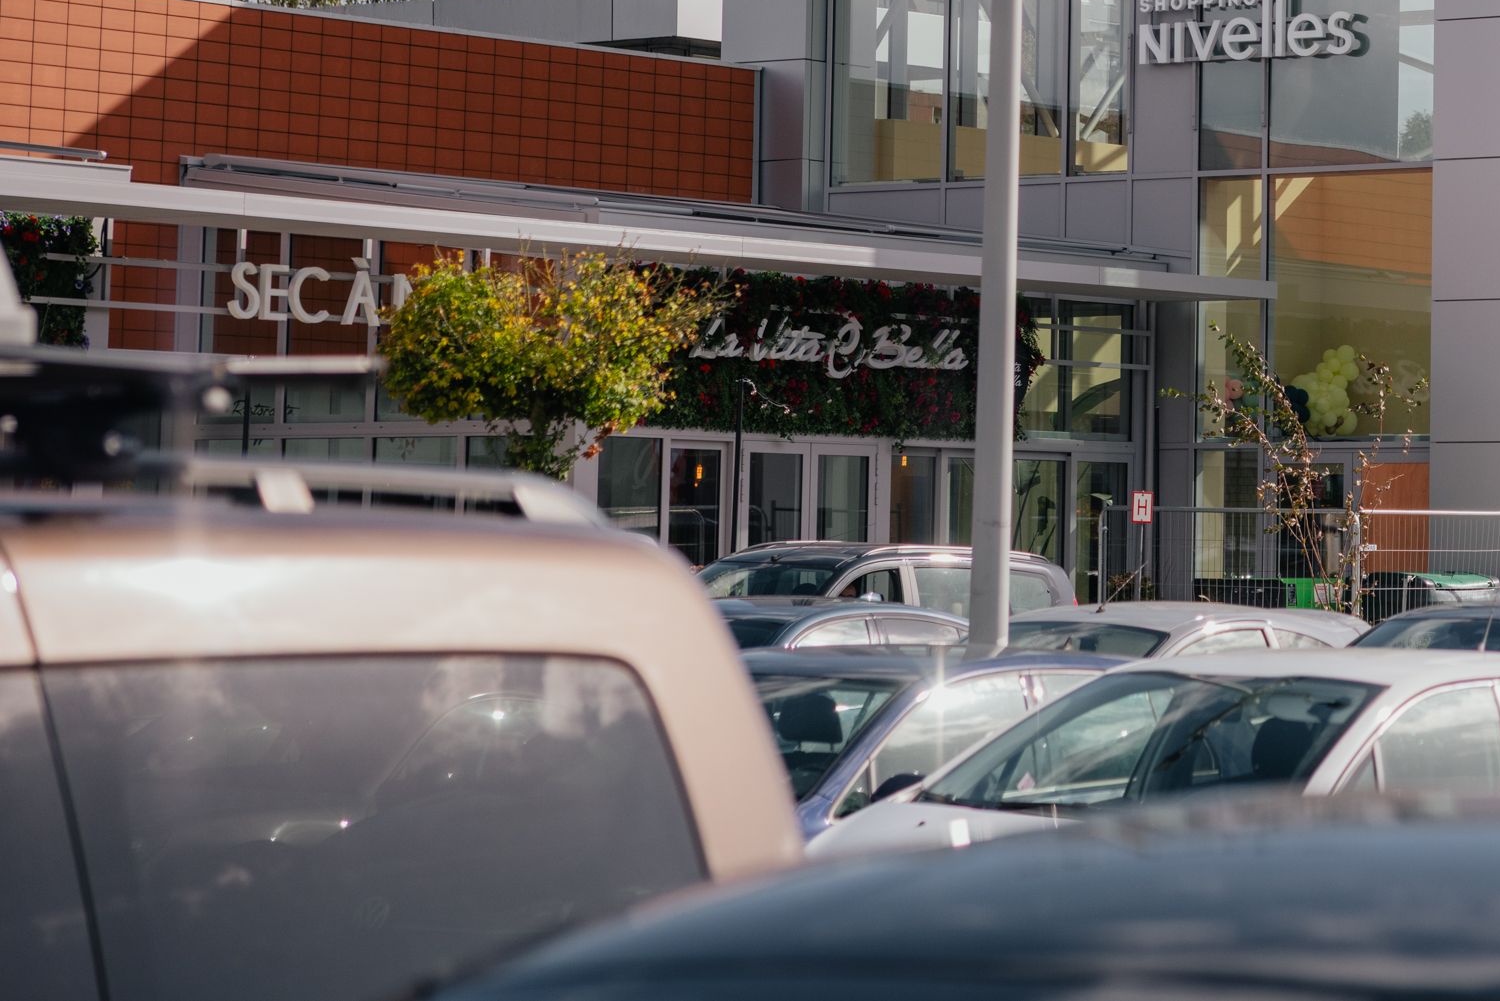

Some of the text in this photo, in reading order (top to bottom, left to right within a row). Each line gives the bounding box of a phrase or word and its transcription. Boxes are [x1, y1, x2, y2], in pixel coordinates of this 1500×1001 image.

[227, 261, 332, 324] SEC
[341, 256, 381, 327] À
[688, 314, 744, 359] La
[752, 314, 826, 361] Vita
[865, 319, 969, 370] Bella
[1137, 498, 1148, 516] H
